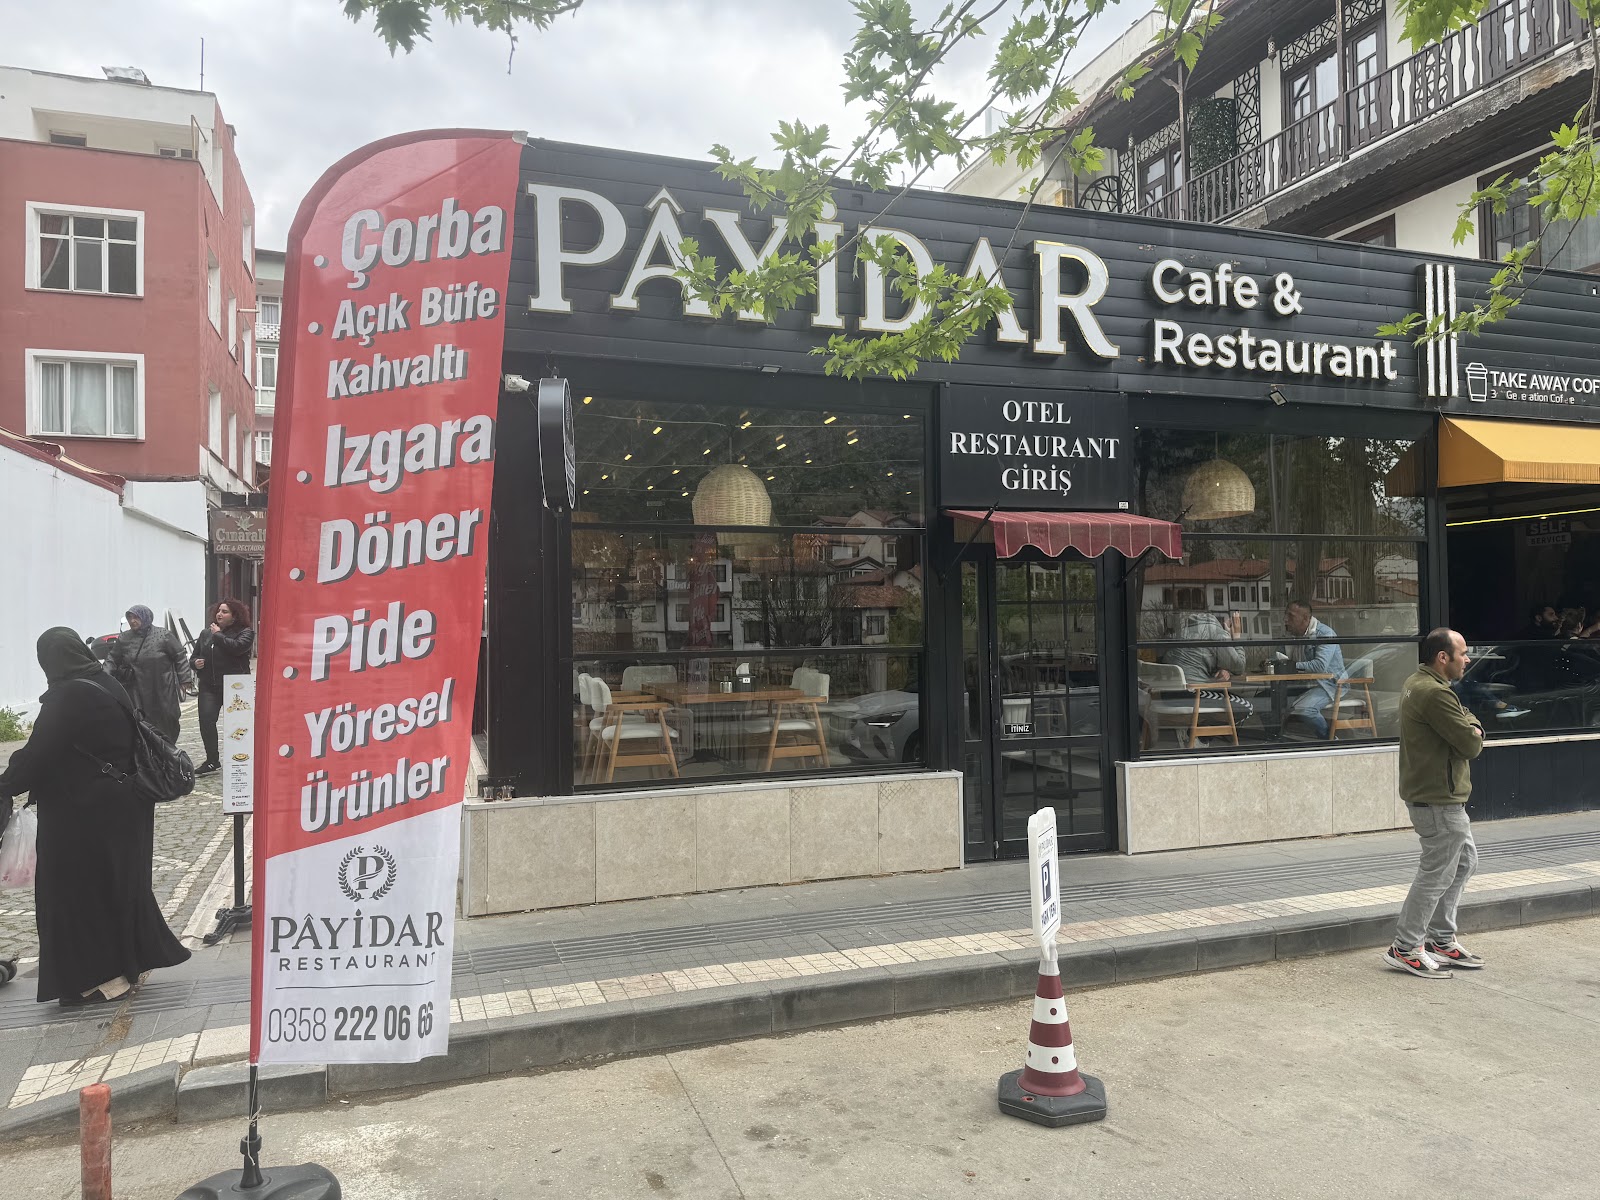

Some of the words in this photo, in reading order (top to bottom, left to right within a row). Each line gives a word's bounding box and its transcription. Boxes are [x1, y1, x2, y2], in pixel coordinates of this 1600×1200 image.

[341, 197, 503, 289] Çorba
[331, 292, 410, 345] Açık
[419, 281, 498, 326] Büfe
[1152, 259, 1259, 309] Cafe
[1273, 272, 1304, 315] &
[326, 343, 467, 399] Kahvaltı
[1153, 319, 1398, 382] Restaurant
[1490, 371, 1527, 389] TAKE
[1529, 374, 1570, 392] AWAY
[1002, 399, 1072, 425] OTEL
[323, 414, 495, 494] Izgara
[950, 432, 1120, 459] RESTAURANT
[1001, 463, 1072, 497] GİRİŞ
[317, 508, 481, 583] Döner
[1530, 520, 1567, 535] SELF
[1531, 535, 1566, 545] SERVICE
[310, 600, 436, 681] Pide
[304, 677, 454, 758] Yöresel
[300, 755, 449, 832] Ürünler
[270, 909, 445, 953] PÂYİDAR
[268, 1007, 327, 1043] 0358
[334, 1005, 378, 1041] 222
[384, 1005, 411, 1041] 06
[417, 1001, 434, 1039] 66
